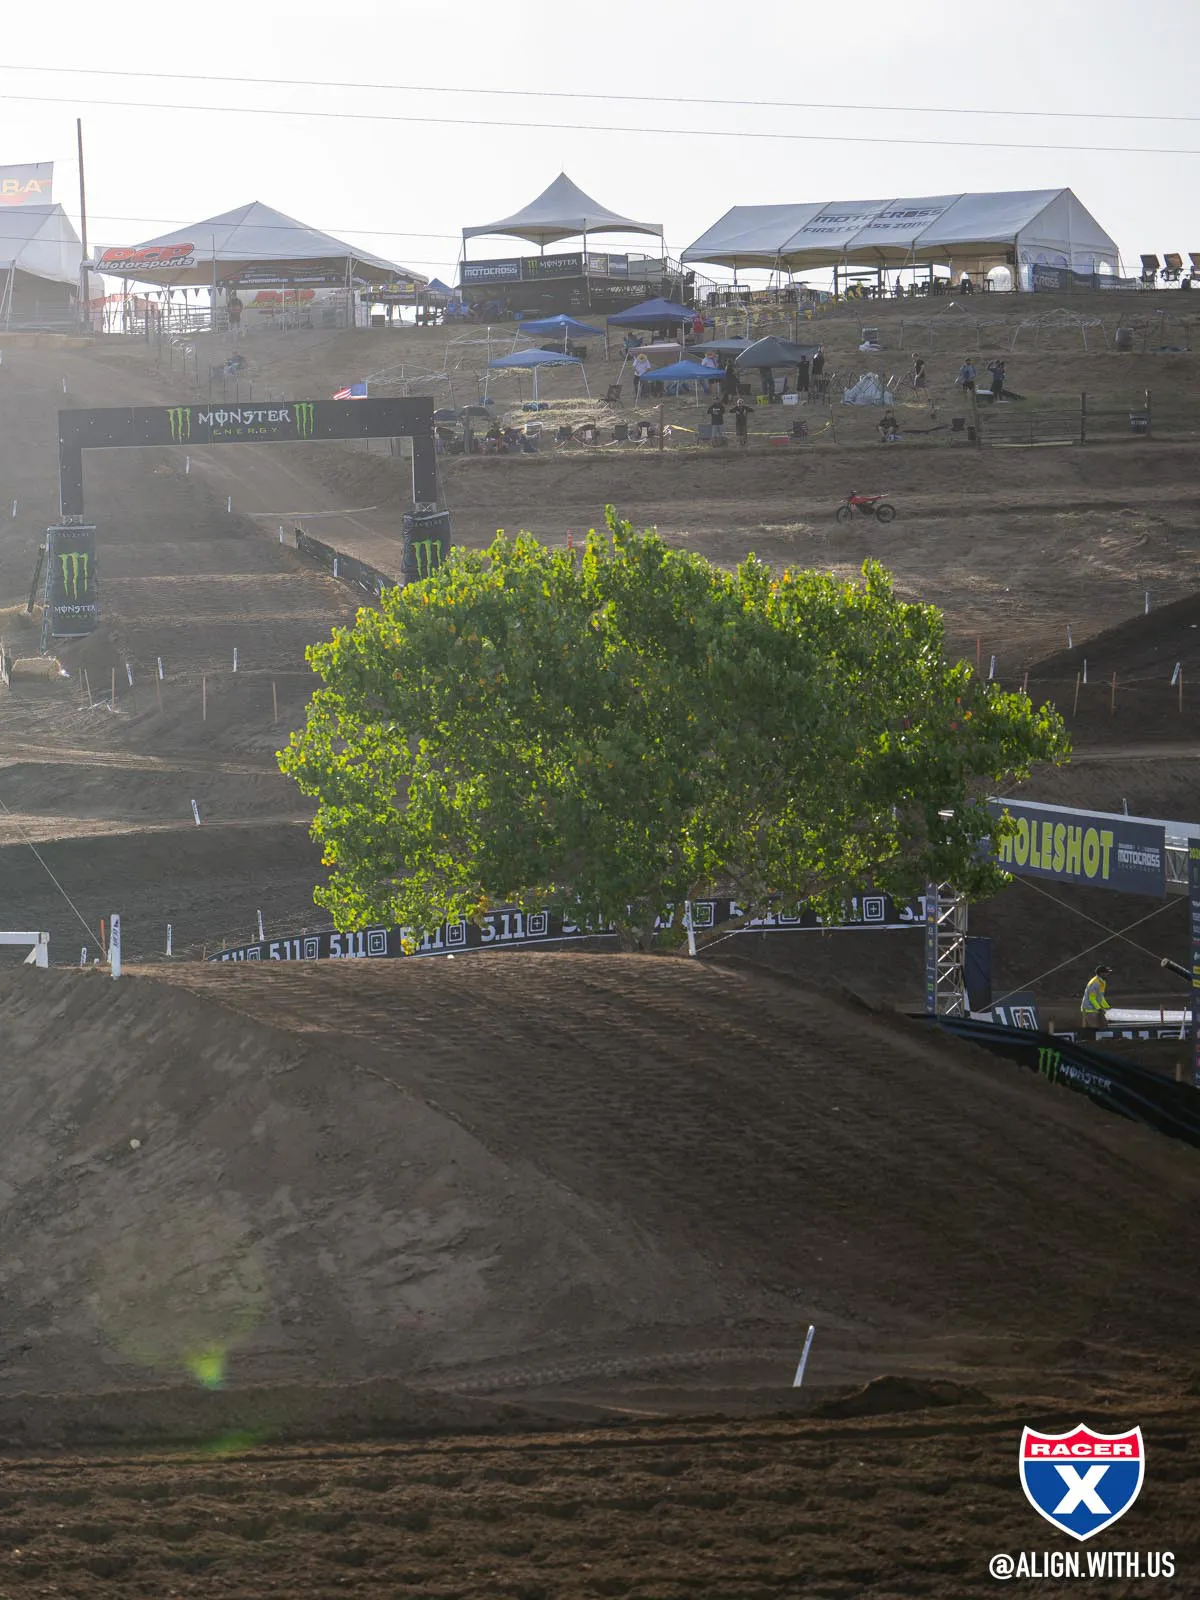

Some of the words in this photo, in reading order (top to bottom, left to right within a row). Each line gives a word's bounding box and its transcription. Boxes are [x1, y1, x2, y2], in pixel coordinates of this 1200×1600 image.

[96, 257, 194, 271] Motorsports
[464, 266, 518, 278] MOTOCROSS
[539, 258, 578, 269] MONSTER
[198, 408, 291, 427] MONSTER
[213, 427, 280, 436] ENERGY
[999, 816, 1114, 880] HOLESHOT
[1118, 849, 1160, 868] MOTOCROSS
[480, 913, 525, 942] 5.11
[269, 940, 300, 961] 511
[329, 931, 366, 959] 5.11
[1058, 1063, 1112, 1092] MONSTER
